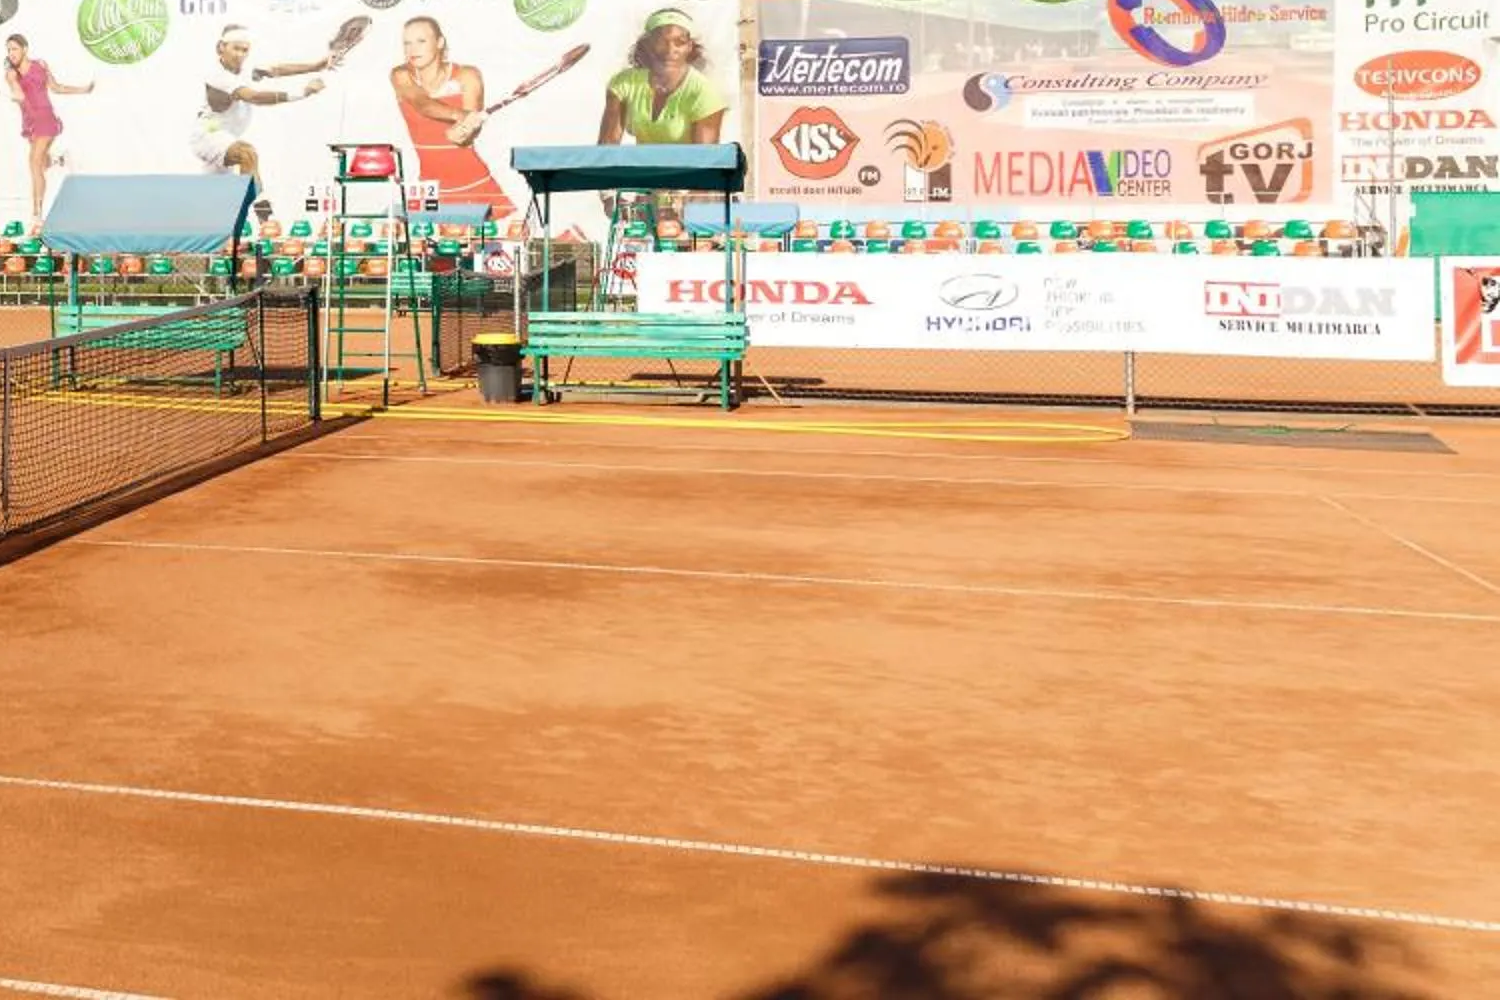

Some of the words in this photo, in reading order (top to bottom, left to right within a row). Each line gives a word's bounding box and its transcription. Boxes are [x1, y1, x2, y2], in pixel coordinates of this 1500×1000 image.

[1269, 4, 1328, 22] Service
[1364, 13, 1406, 33] Pro
[1413, 9, 1491, 31] Circuit
[763, 42, 903, 83] Mertecom
[1003, 73, 1138, 92] Consulting
[1146, 71, 1269, 91] Company
[1357, 66, 1477, 85] TESIVCONS
[760, 82, 906, 95] www.mertecom.ro
[1338, 109, 1498, 131] HONDA
[1229, 141, 1314, 161] GORJ
[974, 151, 1094, 196] MEDIA
[1116, 180, 1172, 197] CENTER
[665, 279, 875, 305] HONDA
[769, 311, 786, 324] of
[790, 311, 856, 325] Dreams
[1219, 319, 1279, 333] SERVICE
[1286, 321, 1381, 336] MULTIMARCA
